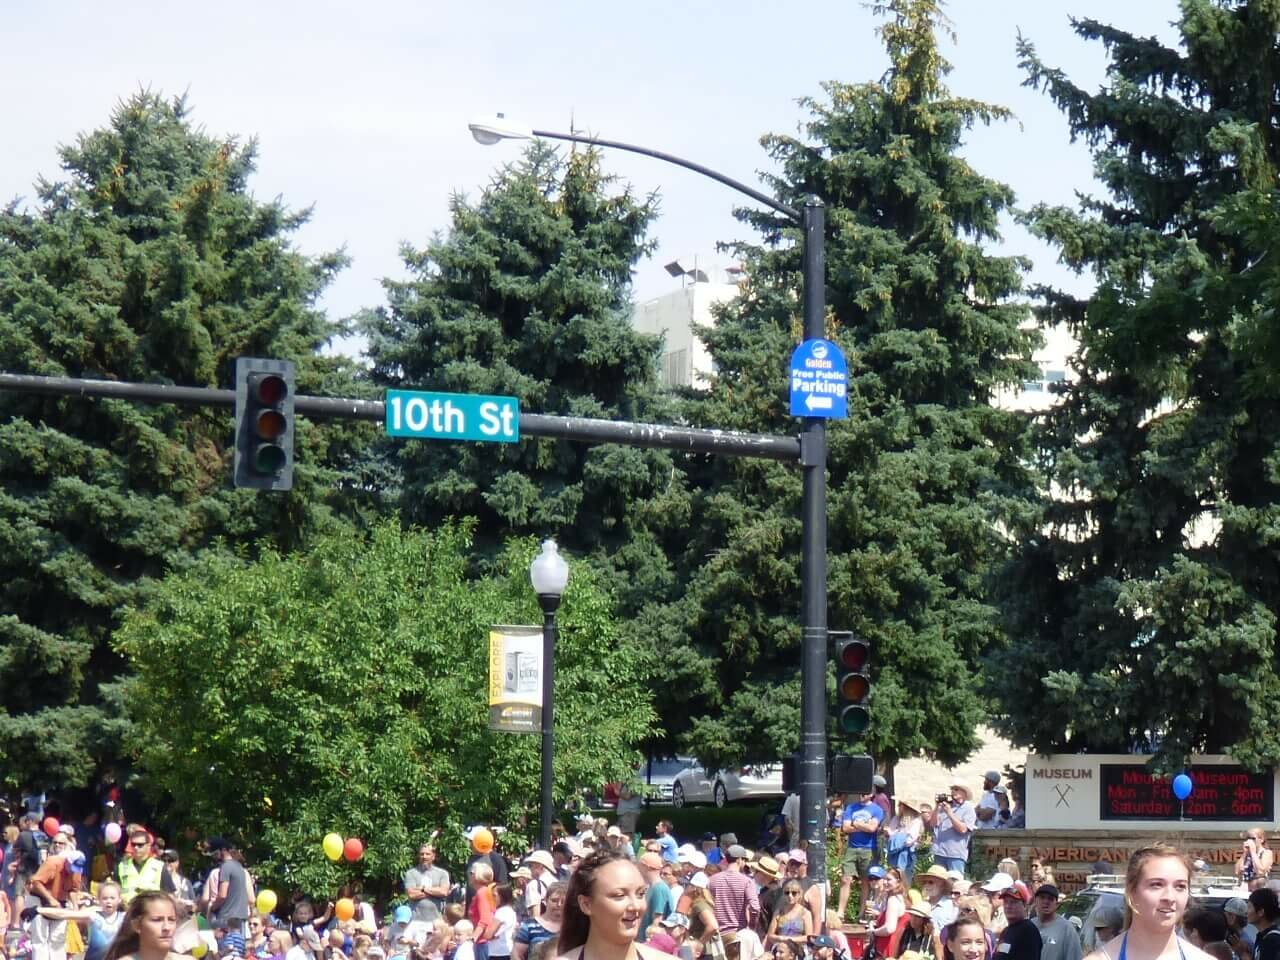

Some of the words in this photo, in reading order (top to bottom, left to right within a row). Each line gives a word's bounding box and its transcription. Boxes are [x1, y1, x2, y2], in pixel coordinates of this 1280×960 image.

[792, 369, 814, 378] Free
[815, 370, 845, 380] Public
[792, 378, 846, 397] Parking
[391, 397, 464, 433] 10th
[479, 402, 514, 436] St
[1033, 769, 1092, 779] MUSEUM
[1190, 770, 1249, 785] Museum
[1107, 785, 1136, 798] Mon
[1111, 801, 1173, 815] Saturday
[1028, 847, 1128, 862] AMERICAN
